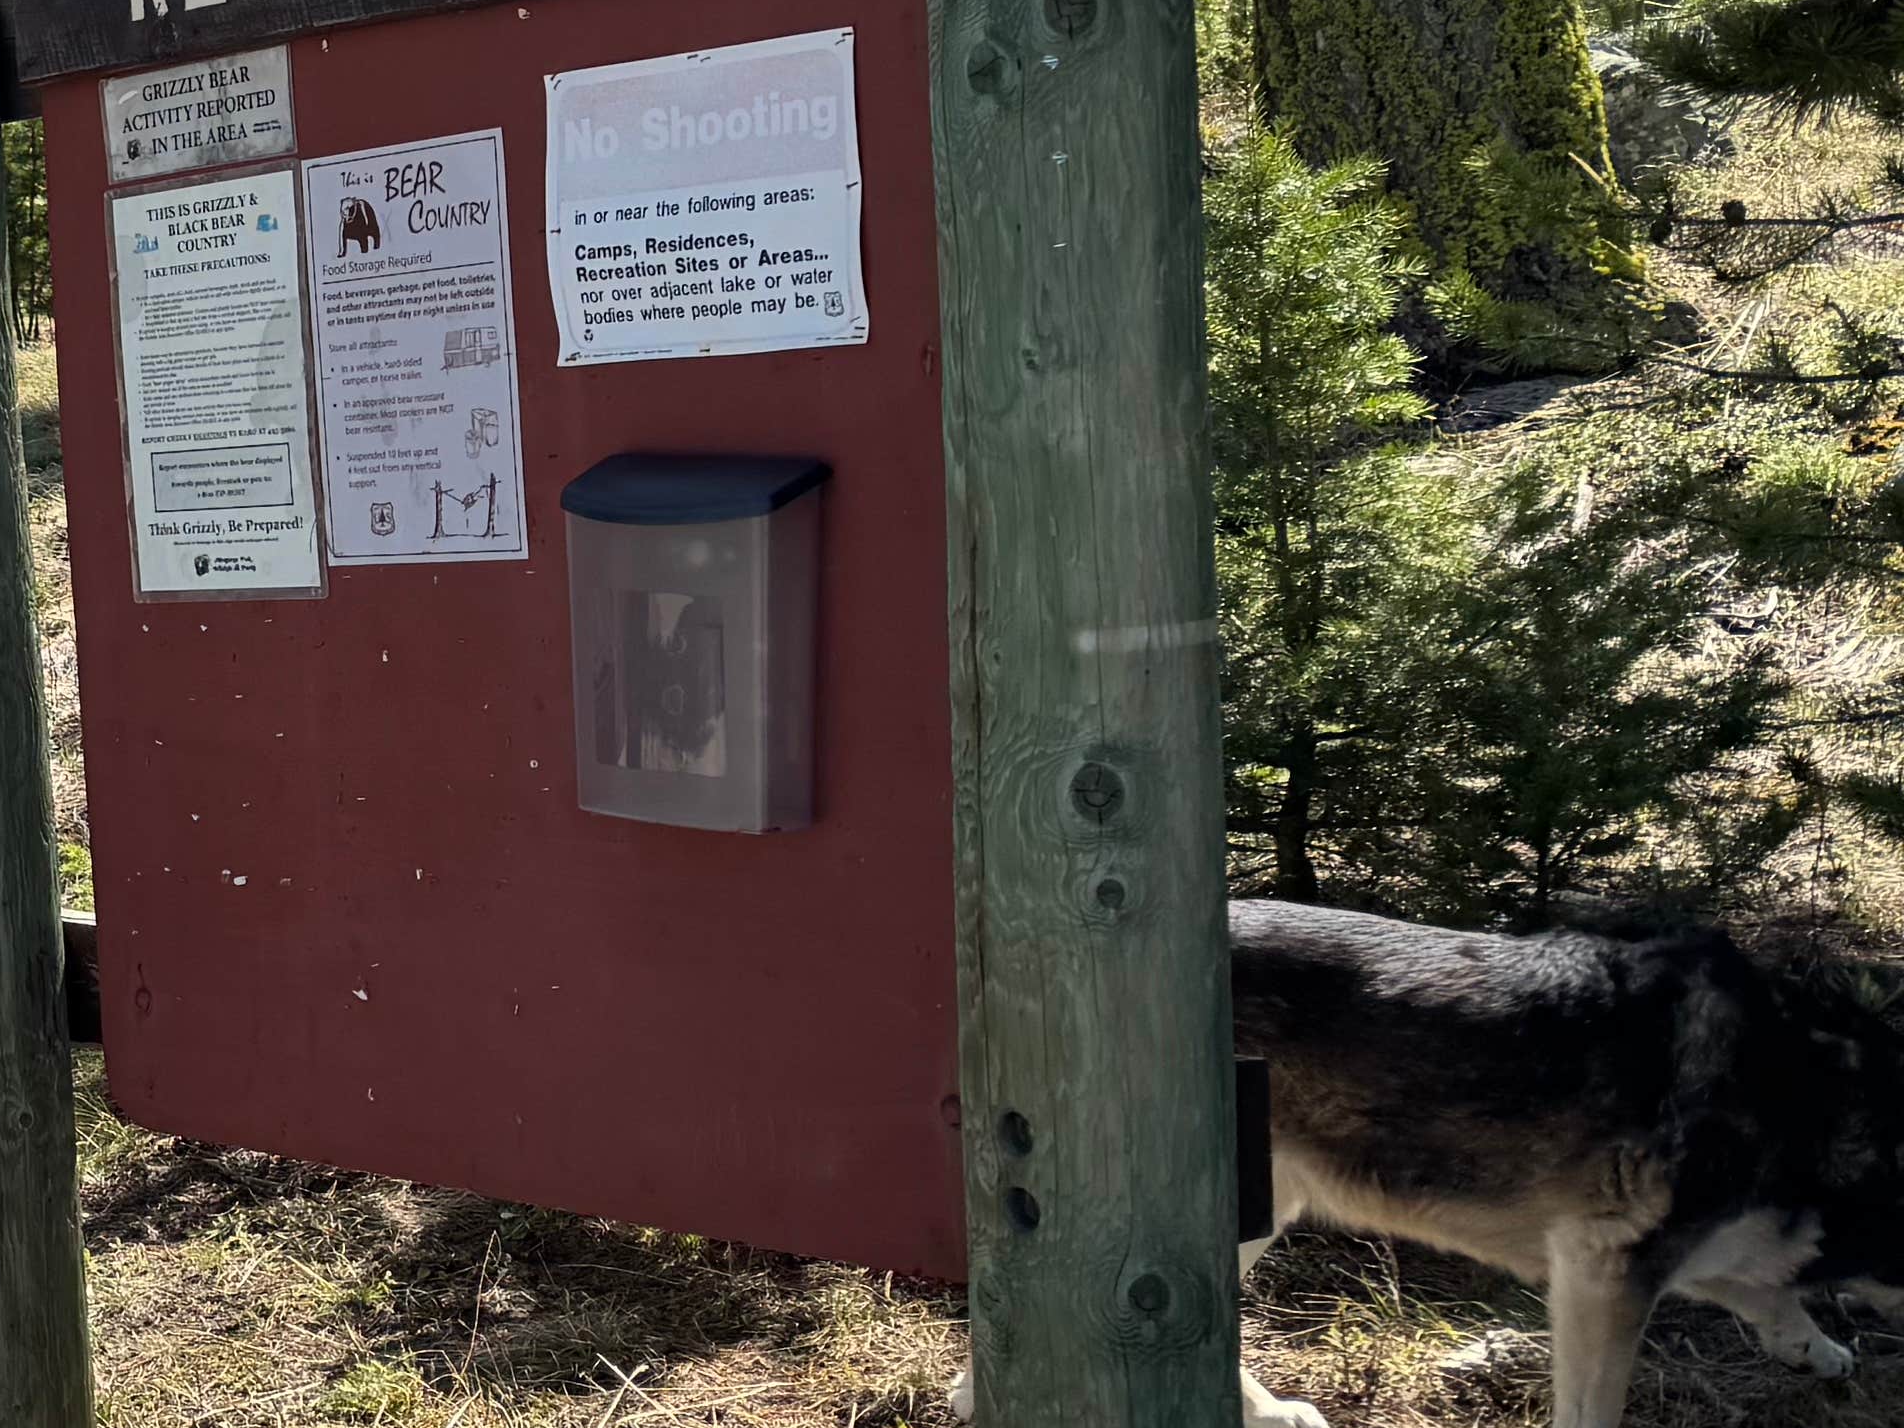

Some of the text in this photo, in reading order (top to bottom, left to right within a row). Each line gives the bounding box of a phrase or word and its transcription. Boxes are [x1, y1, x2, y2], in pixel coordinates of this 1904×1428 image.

[143, 66, 250, 101] GRIZZLY BEAR
[122, 89, 275, 133] ACTIVITY REPORTED
[152, 137, 167, 154] IN
[172, 130, 202, 150] THE
[207, 123, 247, 145] AREA
[565, 91, 837, 163] No Shooting
[341, 161, 446, 202] This is BEAR
[147, 193, 258, 222] THIS IS GRIZZLY &
[575, 188, 814, 225] in or near the following areas:
[168, 214, 245, 236] BLACK BEAR
[178, 233, 237, 253] COUNTRY
[575, 232, 754, 260] Camps, Residences,
[144, 267, 172, 279] TAKE
[170, 262, 199, 275] THESE
[323, 251, 432, 276] Food Storage Required
[577, 248, 828, 282] Recreation Sites or Areas...
[581, 269, 832, 304] nor over adjacent lake or water
[584, 292, 819, 324] bodies where people may be.
[148, 516, 303, 537] Think Grizzly, Be Prepared!
